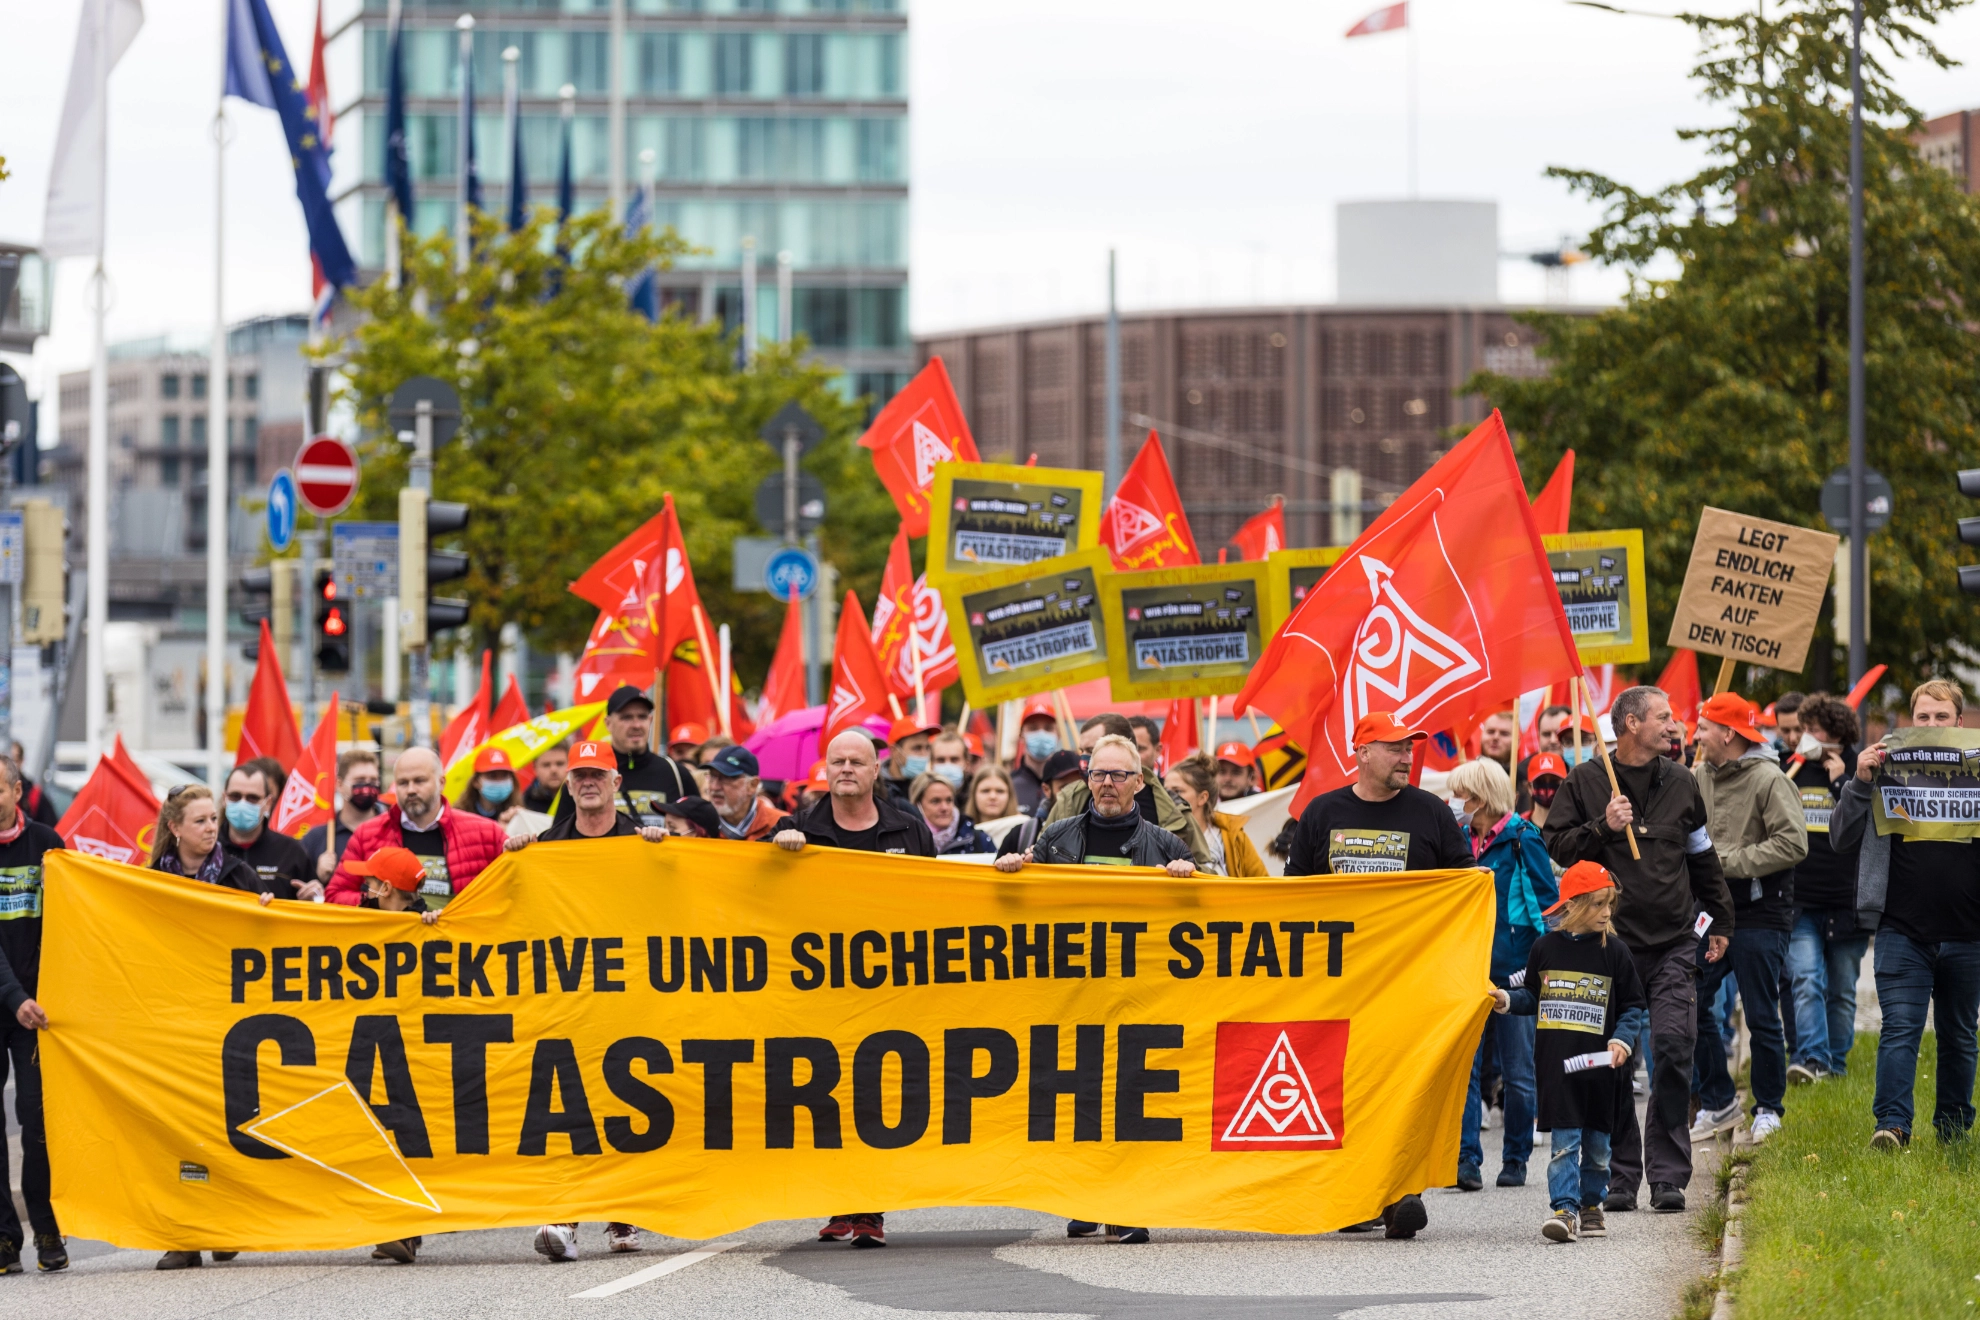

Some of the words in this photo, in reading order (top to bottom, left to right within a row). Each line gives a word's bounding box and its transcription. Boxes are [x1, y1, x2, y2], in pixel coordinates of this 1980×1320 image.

[1738, 527, 1789, 553] LEGT
[1715, 548, 1795, 582] ENDLICH
[1711, 576, 1783, 607] FAKTEN
[1144, 607, 1161, 619] WIR
[1567, 612, 1615, 631] TROPHE
[1720, 605, 1759, 626] AUF
[990, 633, 1092, 665] CATASTROPHE
[1688, 623, 1726, 646] DEN
[1731, 631, 1782, 659] TISCH
[1141, 643, 1245, 664] CATASTROPHE
[1891, 751, 1912, 762] WIR
[1913, 750, 1932, 761] FÜR
[1933, 752, 1960, 762] HIER!
[1884, 788, 1927, 797] PERSPEKTIVE
[1930, 790, 1945, 798] UND
[231, 936, 625, 1003] PERSPEKTIVE
[647, 936, 768, 993] UND
[790, 922, 1148, 990] SICHERHEIT
[1168, 921, 1354, 978] STATT
[1541, 1008, 1603, 1024] CATASTROPHE
[222, 1013, 1184, 1159] CATASTROPHE
